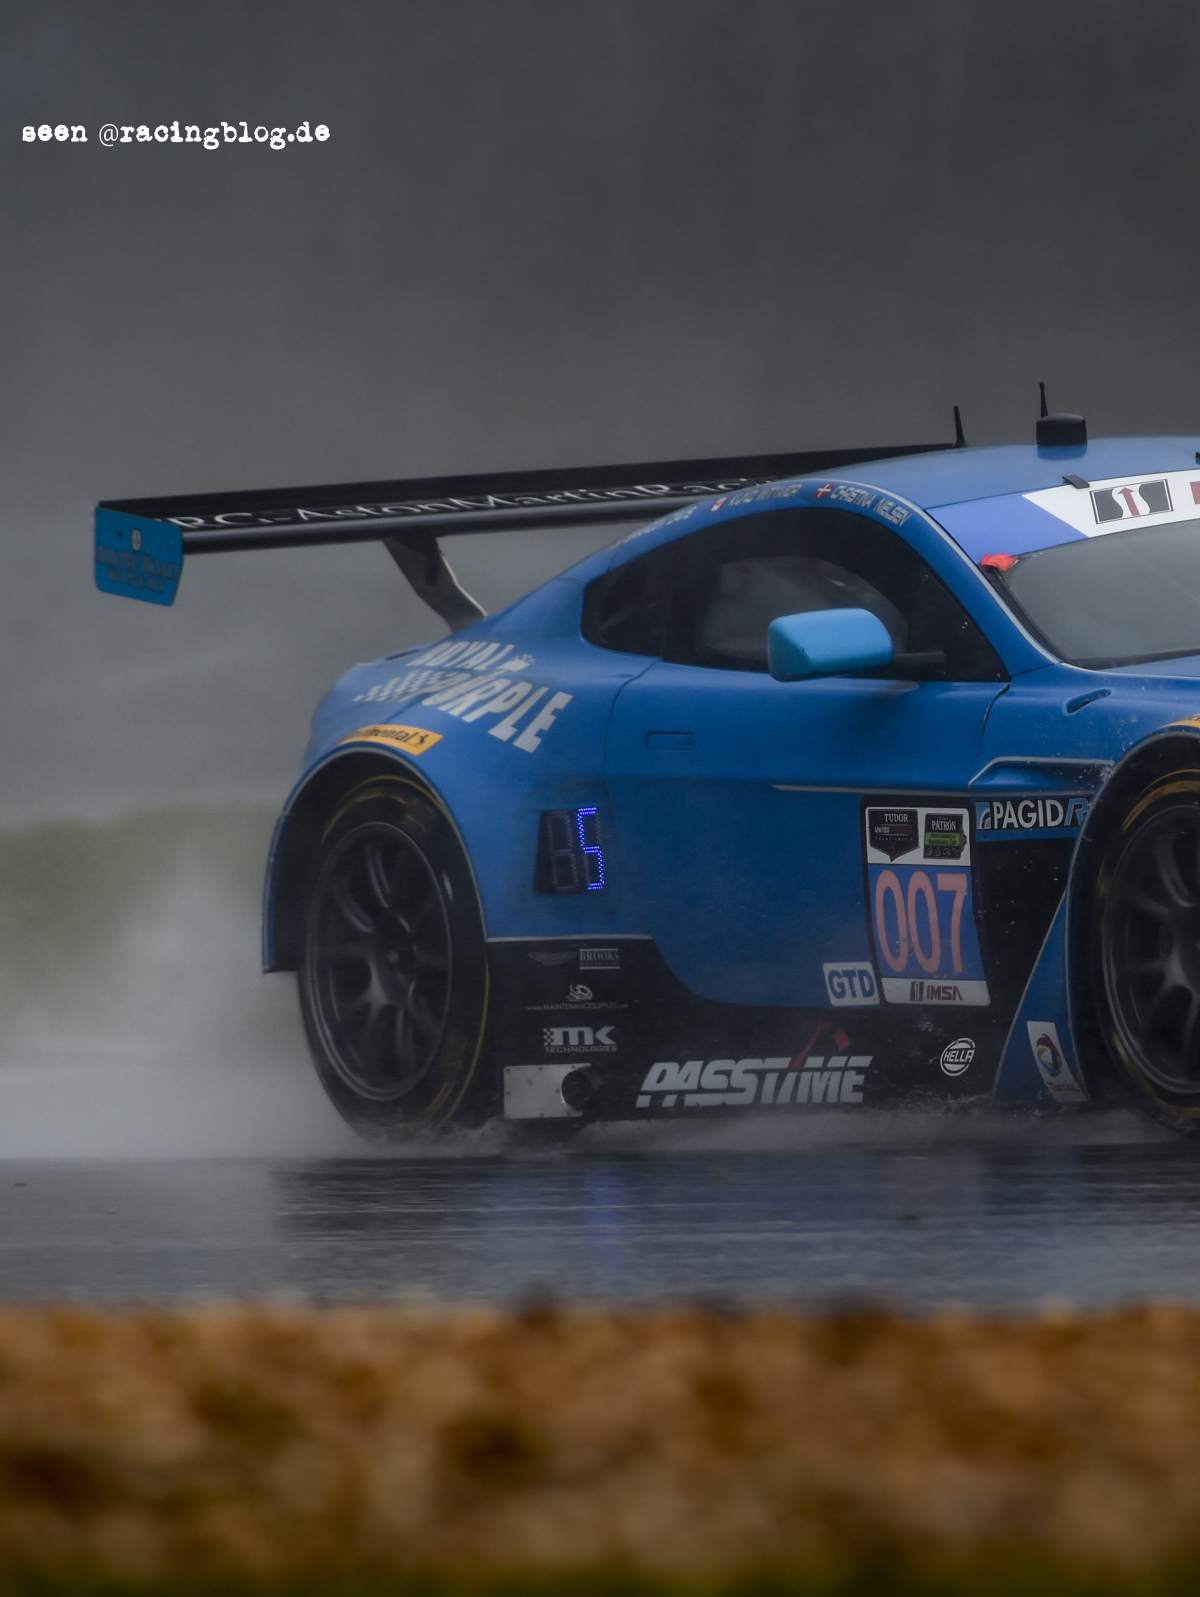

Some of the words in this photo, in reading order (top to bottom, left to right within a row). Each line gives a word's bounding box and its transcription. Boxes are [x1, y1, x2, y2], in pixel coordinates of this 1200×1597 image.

[407, 641, 514, 671] ROYAL
[399, 667, 573, 753] PURPLE
[884, 813, 909, 823] TUDOR
[992, 799, 1064, 830] PAGID
[577, 807, 604, 890] 5
[875, 869, 968, 975] 007
[580, 951, 619, 961] BROOKS
[827, 970, 876, 999] GTD
[926, 985, 963, 1001] IMSA
[545, 1045, 617, 1054] TECHNOLOGIES
[943, 1048, 975, 1064] HELLA
[635, 1056, 874, 1107] PASSTIME
